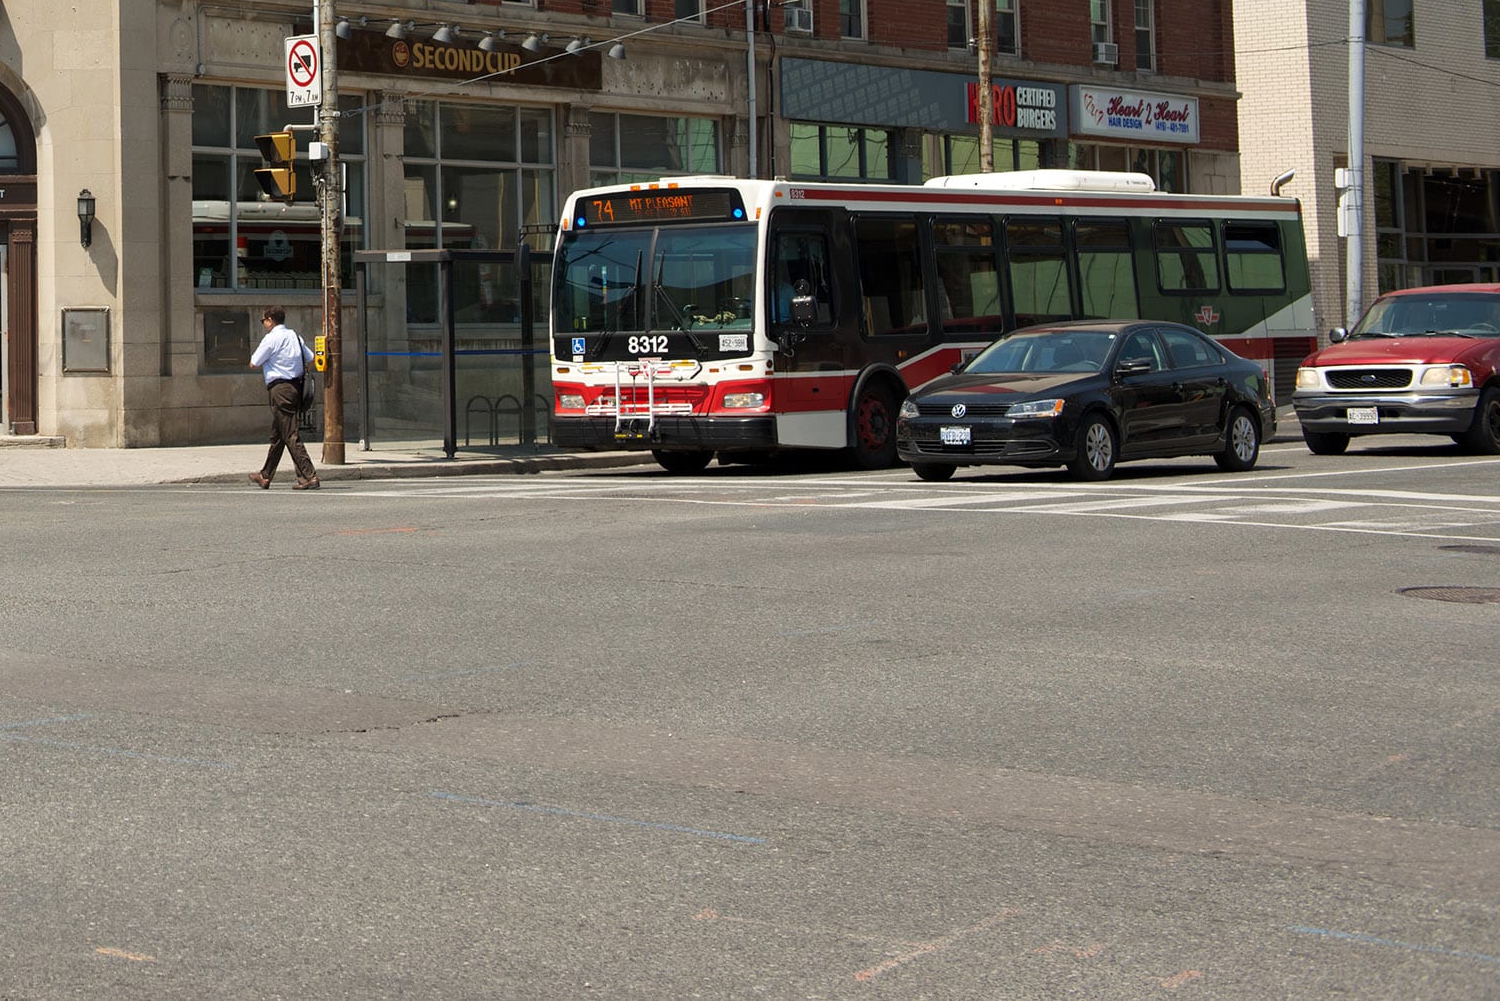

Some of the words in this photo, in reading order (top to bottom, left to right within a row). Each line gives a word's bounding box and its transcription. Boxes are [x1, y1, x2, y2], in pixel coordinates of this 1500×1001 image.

[412, 42, 484, 72] SECOND
[485, 50, 520, 76] CUP
[290, 91, 295, 103] 7
[306, 90, 311, 102] 7
[967, 82, 1016, 127] HRO
[1016, 86, 1056, 108] CERTIFIED
[1016, 107, 1056, 130] BURGERS
[1107, 96, 1145, 118] Heart
[1145, 102, 1152, 125] 2
[1154, 101, 1190, 122] Heart
[1108, 116, 1122, 127] HAIR
[1123, 118, 1142, 129] DESIGN
[593, 199, 614, 221] 74
[630, 198, 642, 210] MT
[645, 195, 693, 209] PLEASANT
[628, 335, 669, 353] 8312
